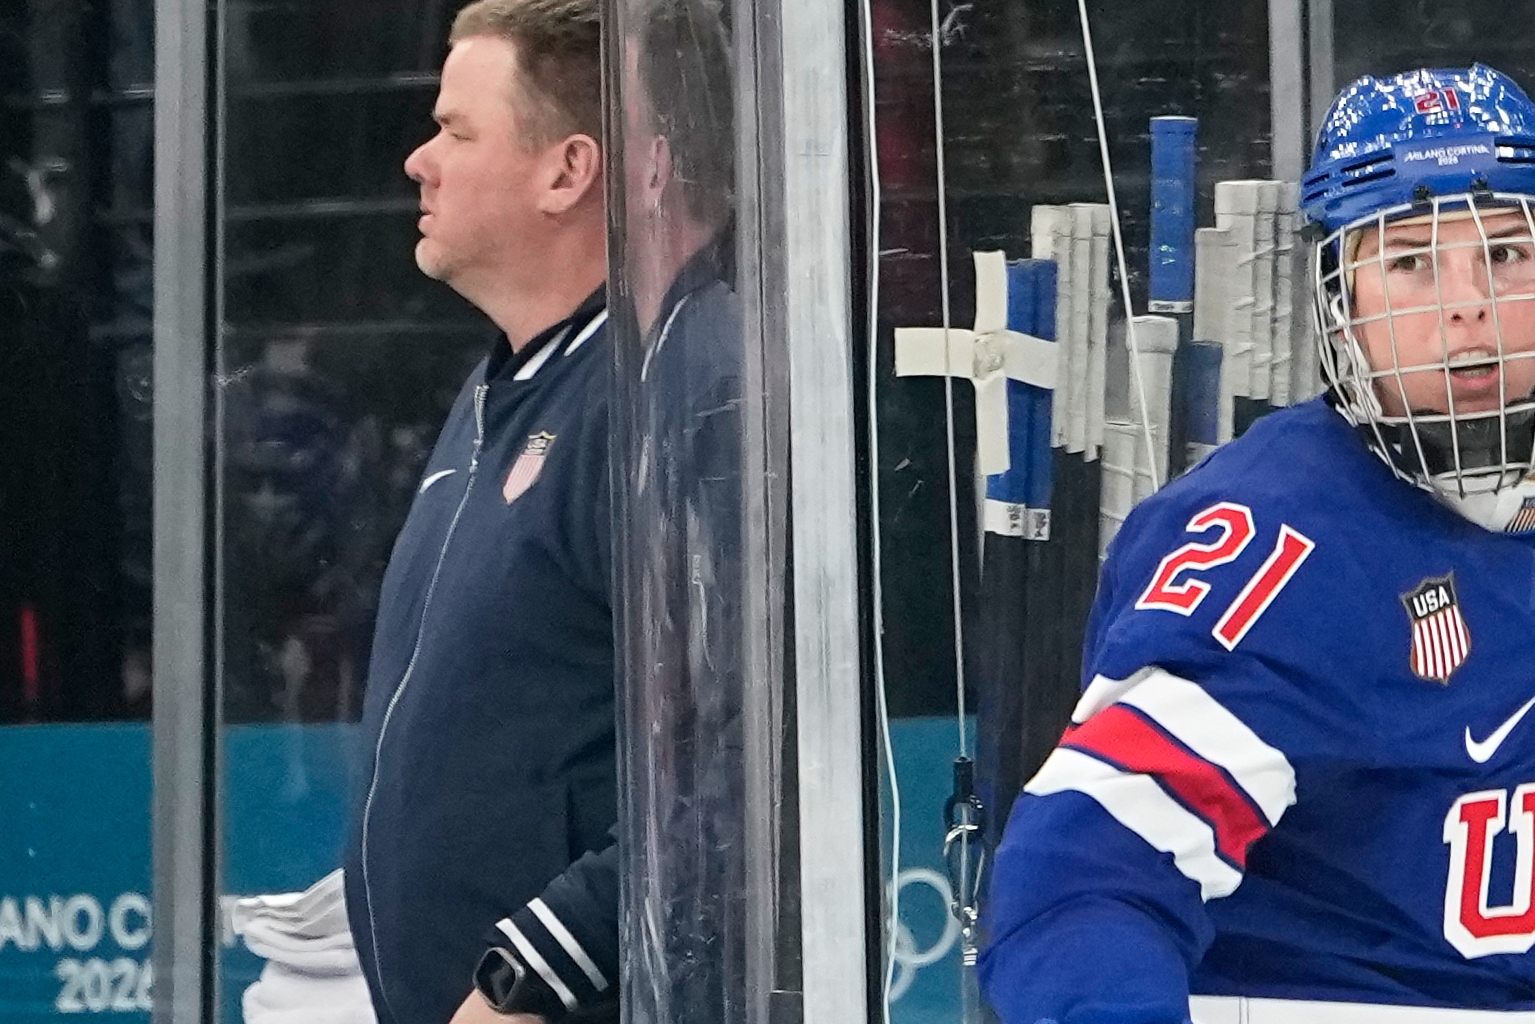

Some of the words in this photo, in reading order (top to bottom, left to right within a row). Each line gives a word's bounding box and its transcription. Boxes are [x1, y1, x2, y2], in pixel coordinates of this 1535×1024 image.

[1413, 86, 1460, 115] 21
[1404, 148, 1445, 163] MILANO
[1446, 143, 1491, 158] CORTINA
[1437, 156, 1459, 166] 2026
[1134, 501, 1315, 652] 21
[1412, 585, 1450, 617] USA
